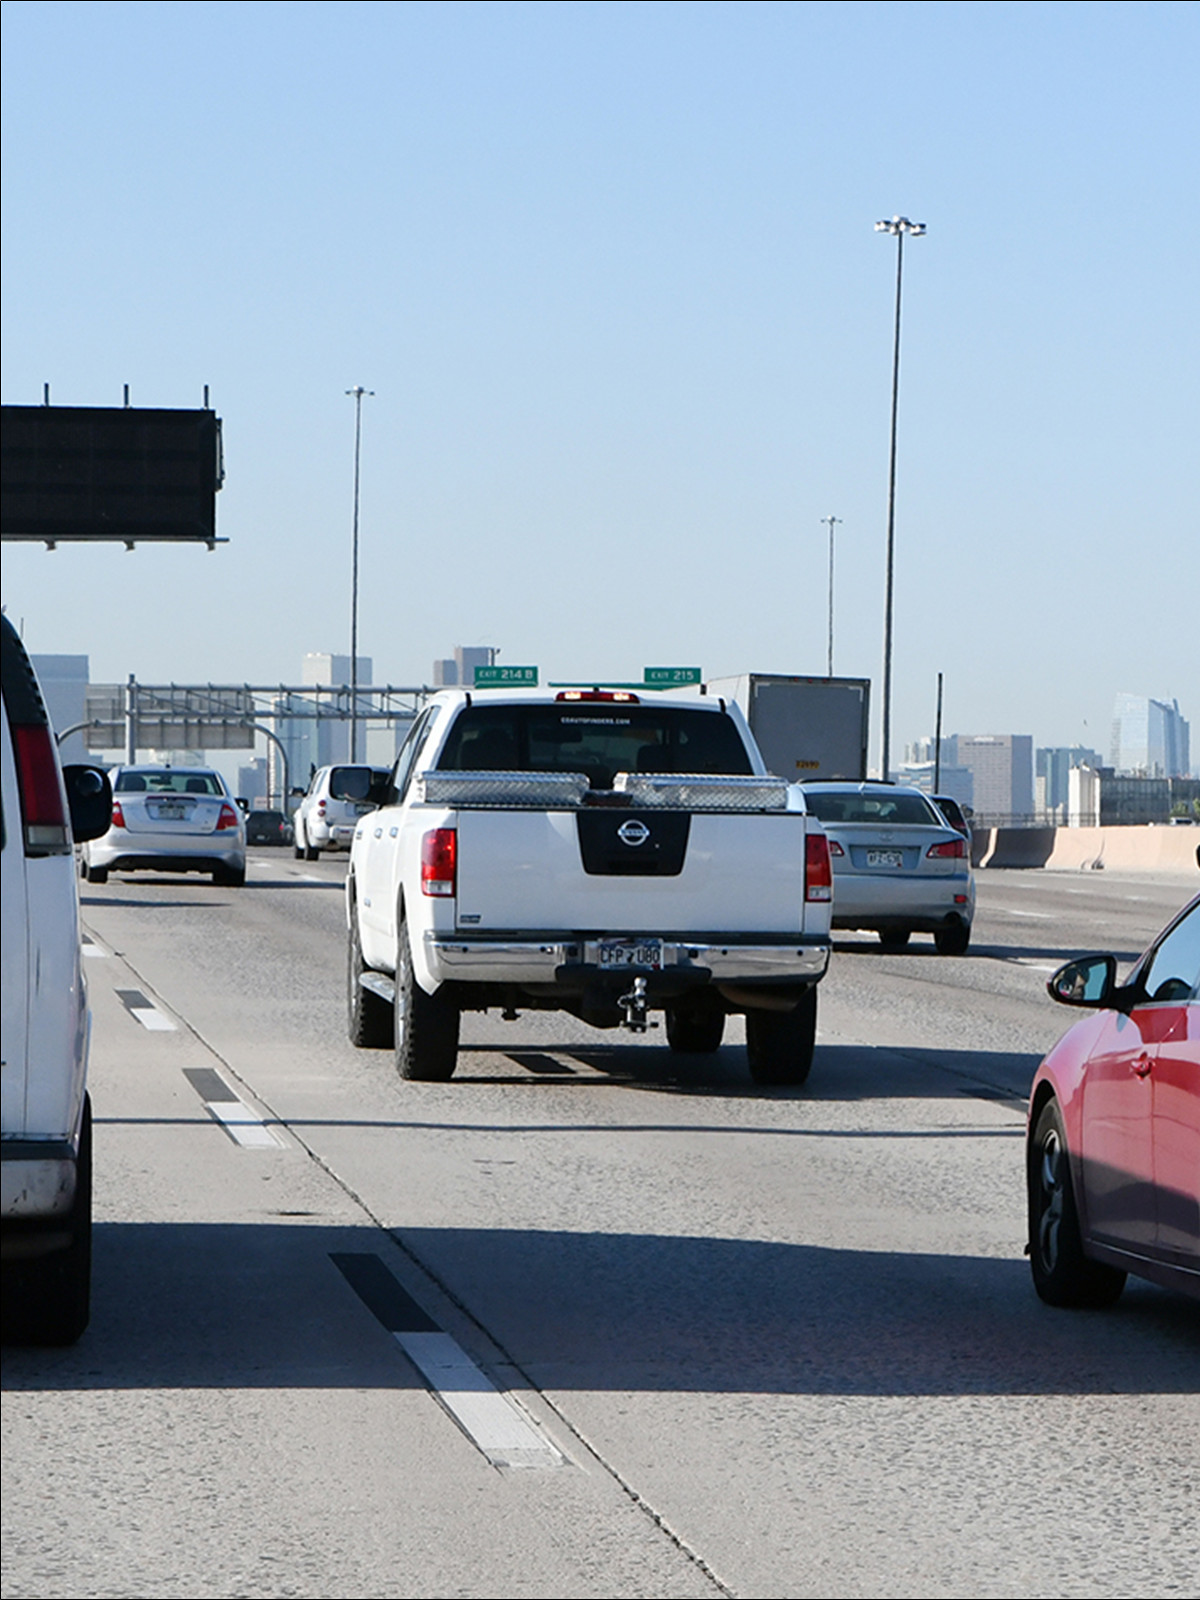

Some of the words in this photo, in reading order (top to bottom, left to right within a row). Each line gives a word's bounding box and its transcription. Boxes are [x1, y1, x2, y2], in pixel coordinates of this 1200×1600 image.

[501, 669, 522, 679] 214
[525, 669, 533, 679] B
[673, 670, 694, 680] 215
